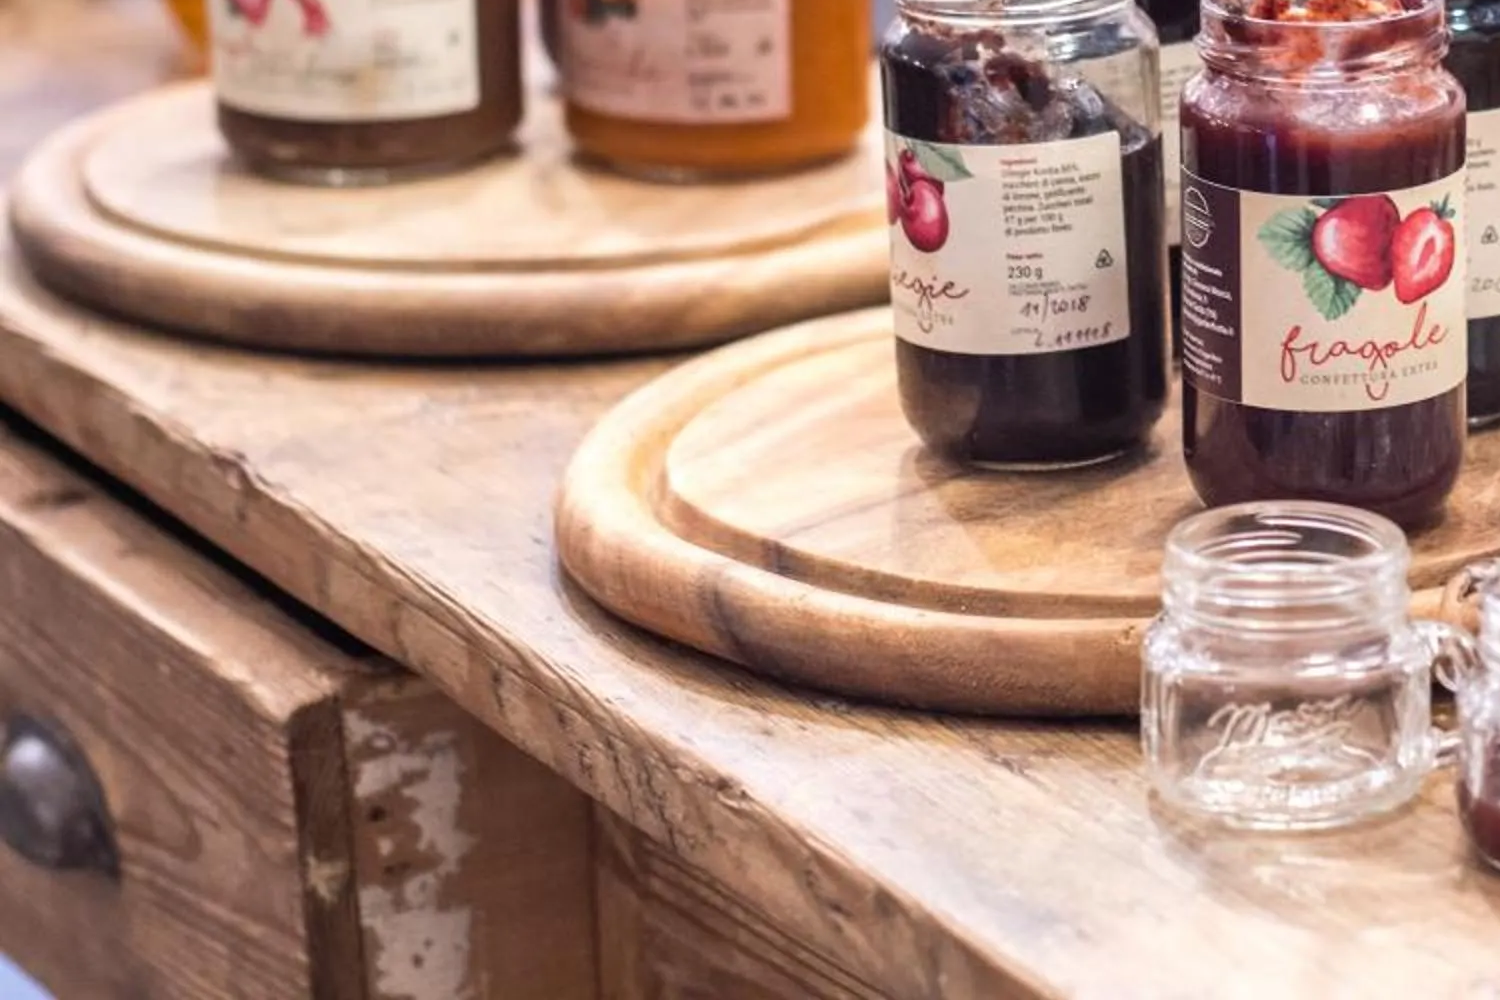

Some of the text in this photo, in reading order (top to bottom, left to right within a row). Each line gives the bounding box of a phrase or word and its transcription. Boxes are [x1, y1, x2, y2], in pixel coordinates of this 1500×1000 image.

[1008, 265, 1043, 280] 230 g
[1280, 301, 1449, 401] fragole
[1300, 370, 1398, 386] CONFETTURA
